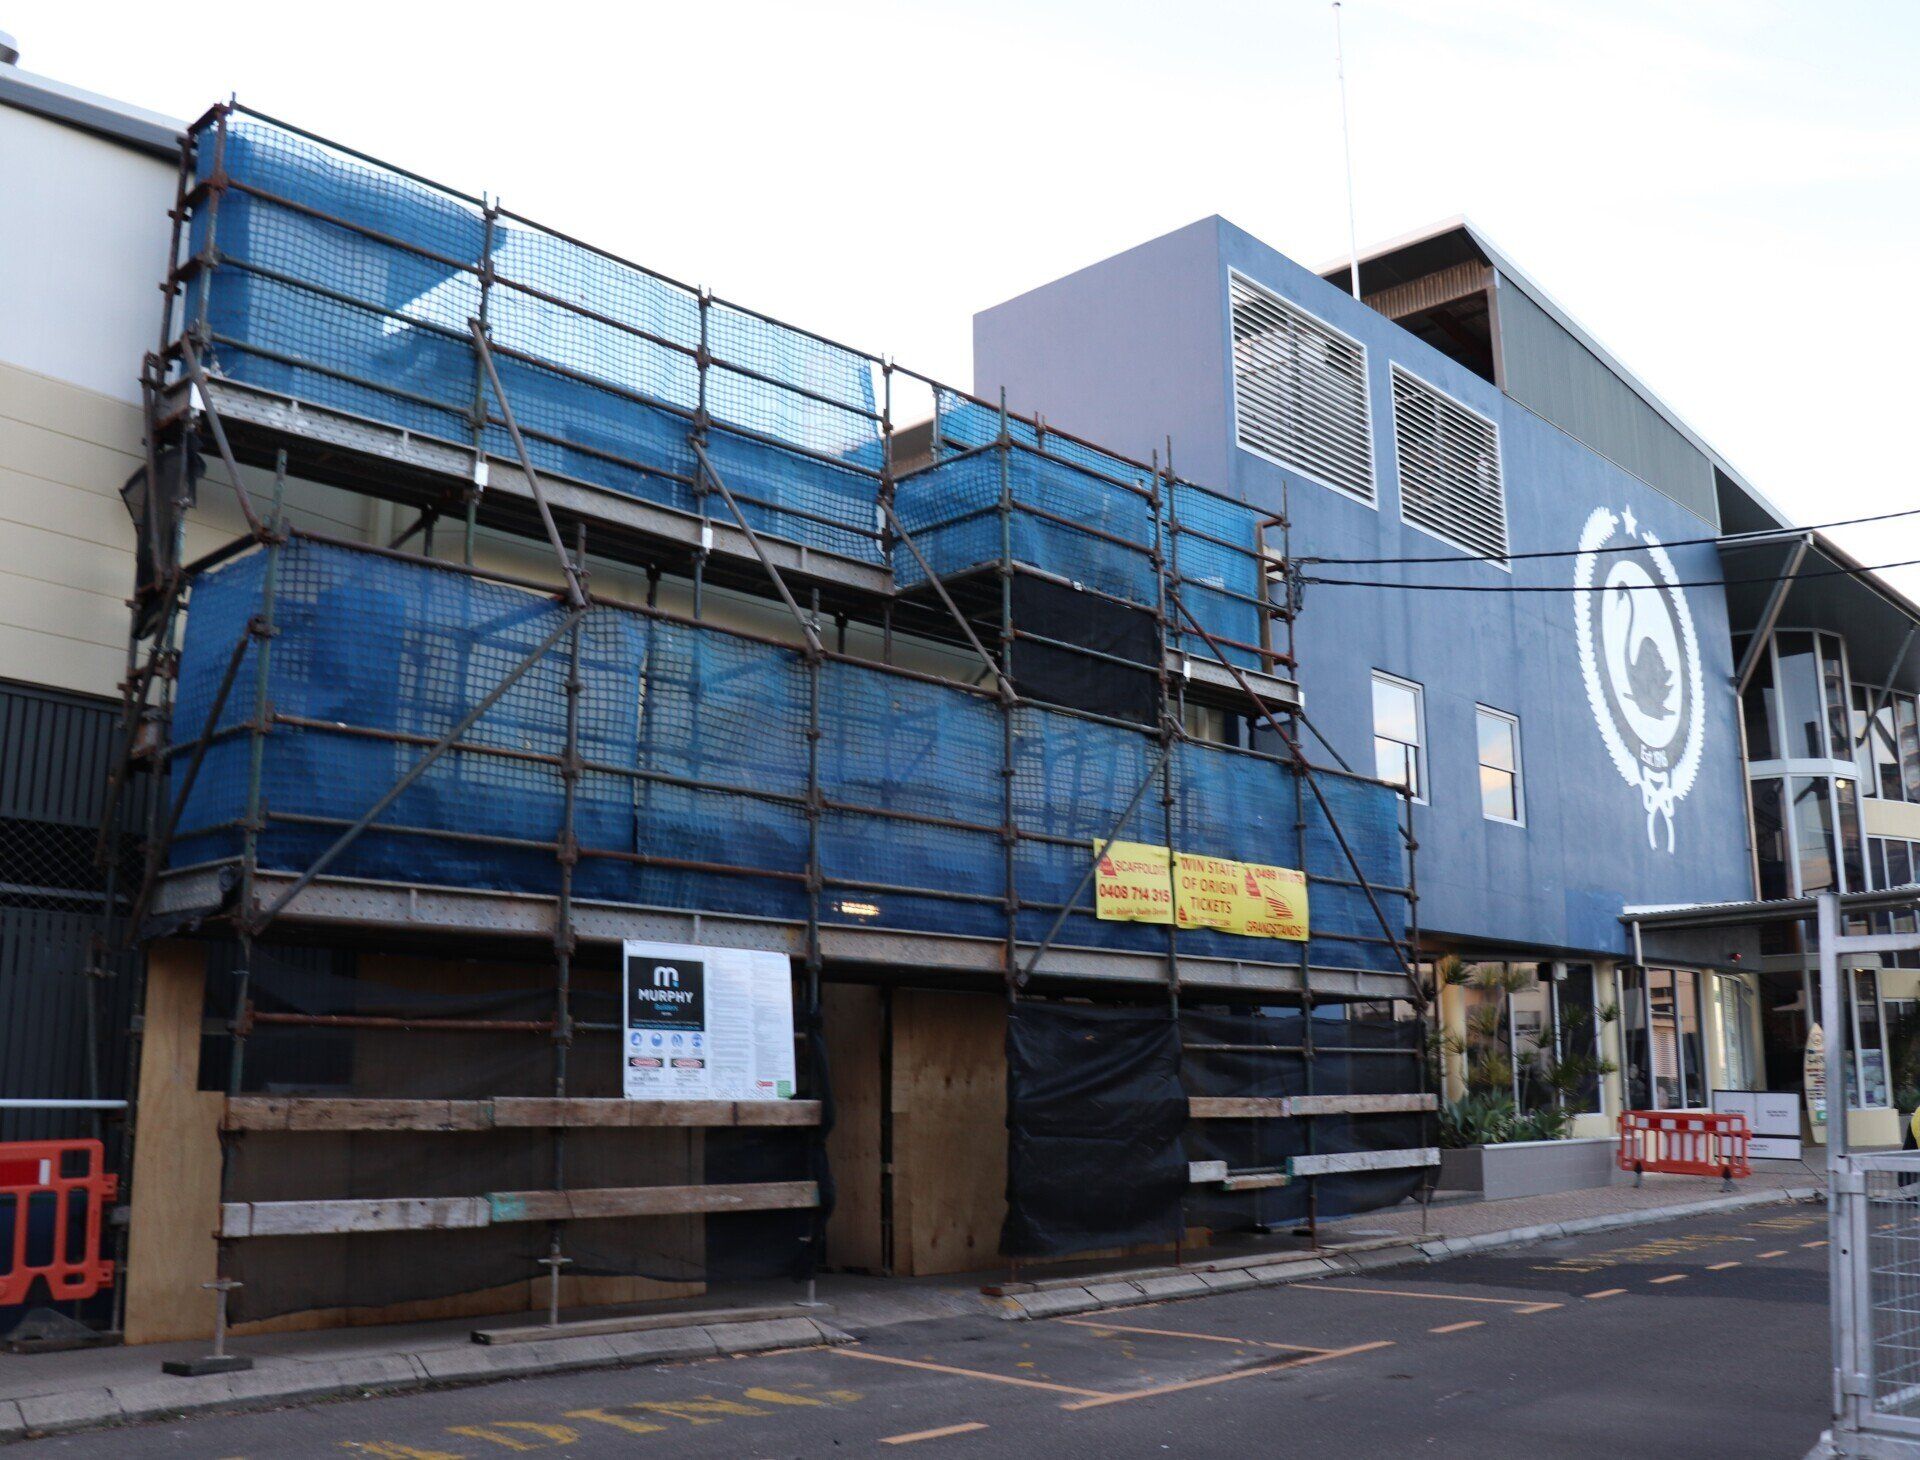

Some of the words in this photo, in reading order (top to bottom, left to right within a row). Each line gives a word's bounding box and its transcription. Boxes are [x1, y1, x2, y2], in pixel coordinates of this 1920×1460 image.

[1181, 857, 1205, 873] WIN
[1208, 861, 1236, 878] STATE
[1131, 886, 1149, 901] 714
[1181, 876, 1198, 890] OF
[1200, 878, 1238, 897] ORIGIN
[1190, 896, 1232, 915] TICKETS
[638, 988, 694, 1004] MURPHY
